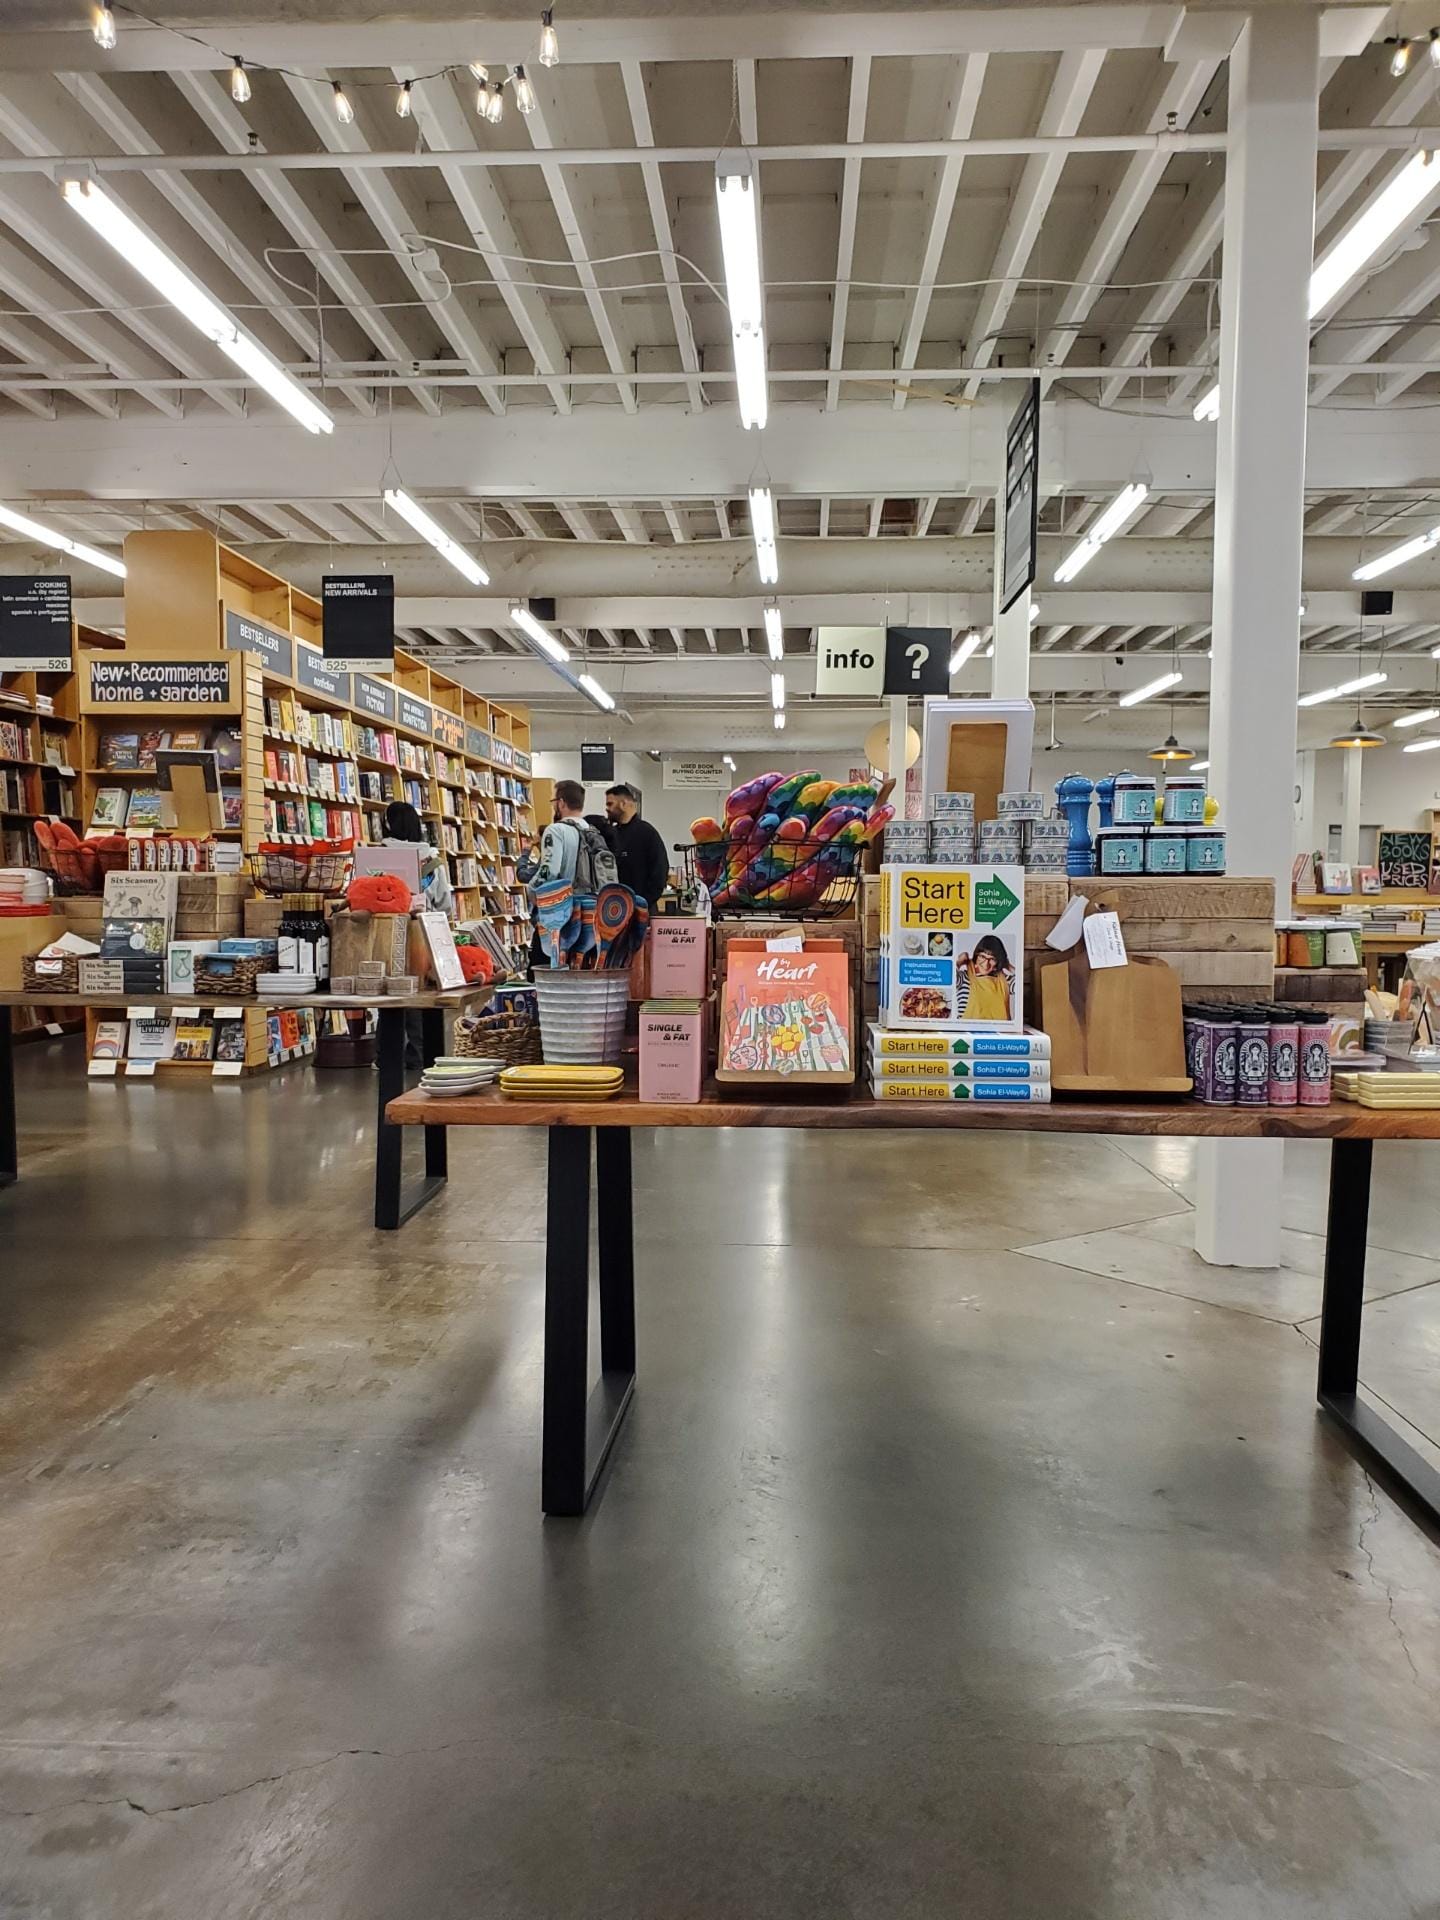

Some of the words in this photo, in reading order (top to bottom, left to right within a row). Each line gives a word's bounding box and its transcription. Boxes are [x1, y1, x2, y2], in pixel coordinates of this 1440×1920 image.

[240, 624, 279, 652] BESTSELLERS
[48, 660, 68, 669] 526
[326, 661, 347, 671] 525
[826, 649, 874, 668] info
[905, 643, 929, 679] ?
[91, 662, 124, 682] New
[131, 662, 229, 682] Recommended
[95, 683, 144, 701] home
[160, 684, 222, 701] garden
[313, 676, 335, 692] nonfiction
[366, 696, 384, 714] FICTION
[403, 712, 427, 732] NONFICTION
[1382, 834, 1427, 845] NEW
[1381, 843, 1430, 861] BOOKS
[1381, 862, 1426, 874] USED
[905, 877, 965, 899] Start
[1381, 874, 1428, 887] PRICES
[906, 902, 963, 924] Here
[757, 958, 818, 980] Heart
[780, 958, 790, 968] by
[647, 1024, 682, 1032] SINGLE
[888, 1041, 914, 1051] Start
[918, 1041, 944, 1051] Here
[888, 1064, 915, 1074] Start
[919, 1064, 944, 1073] Here
[889, 1086, 915, 1096] Start
[919, 1086, 944, 1096] Here
